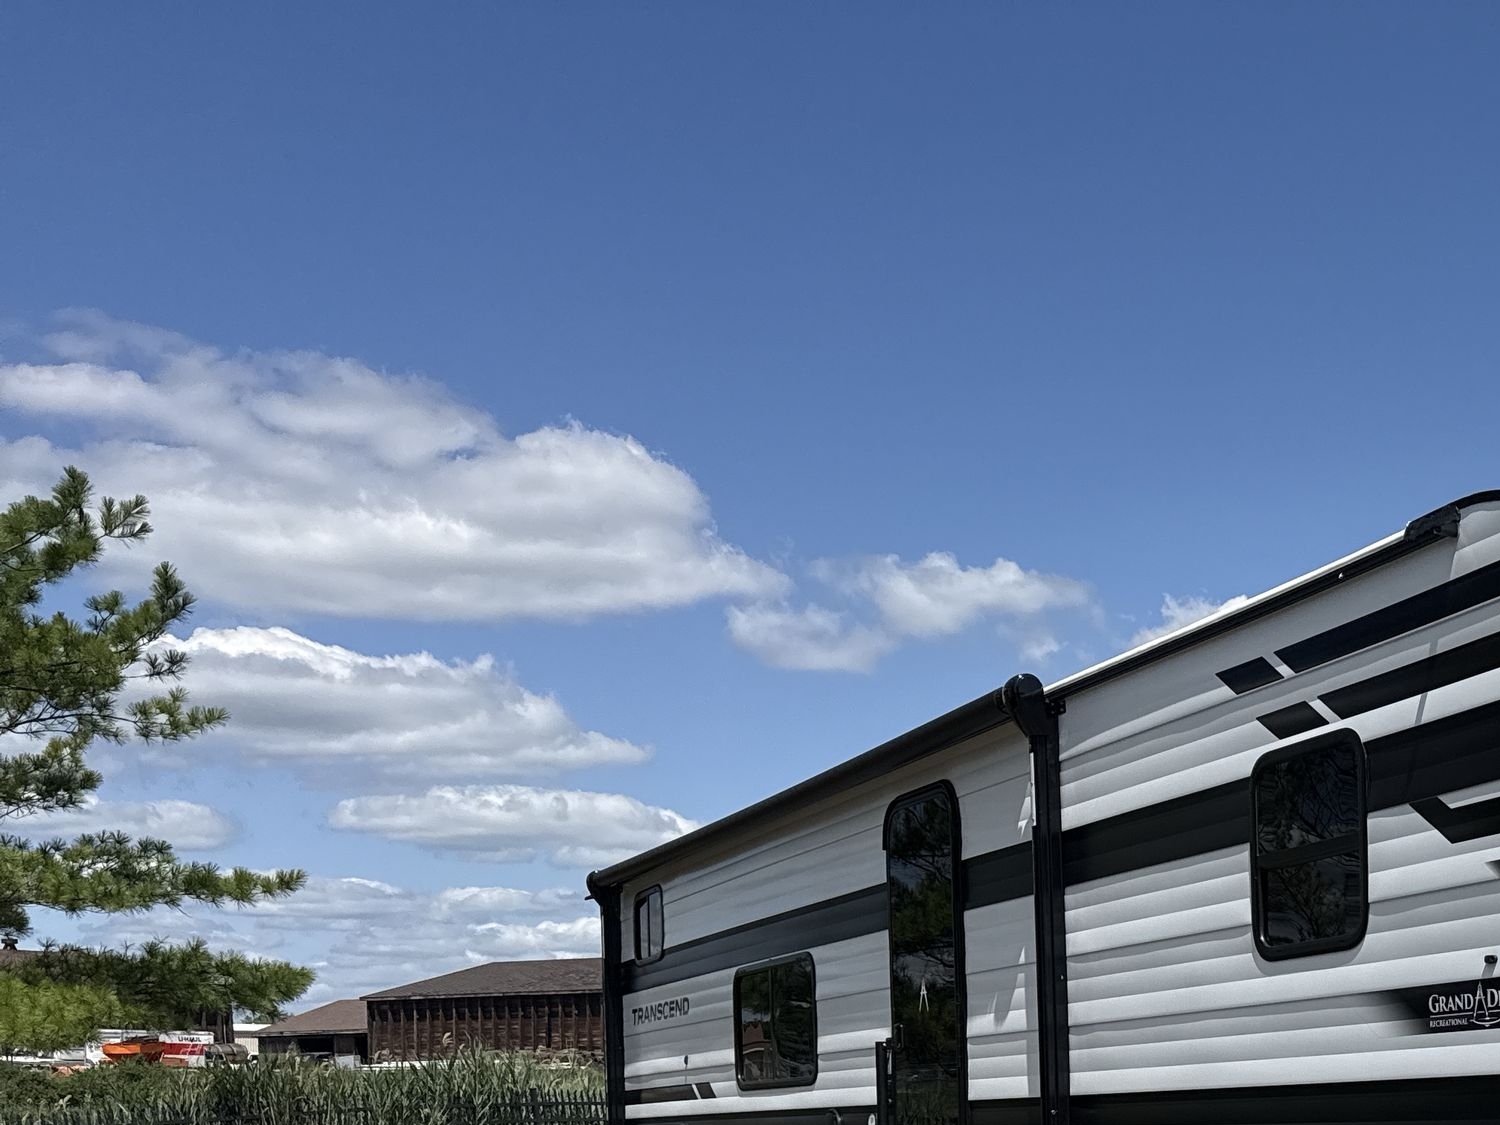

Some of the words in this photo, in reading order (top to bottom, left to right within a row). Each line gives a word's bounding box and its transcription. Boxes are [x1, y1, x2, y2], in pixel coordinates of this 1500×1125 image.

[632, 997, 690, 1026] TRANSCEND
[1428, 993, 1474, 1013] GRAND
[1429, 1017, 1468, 1028] RECREATIONAL
